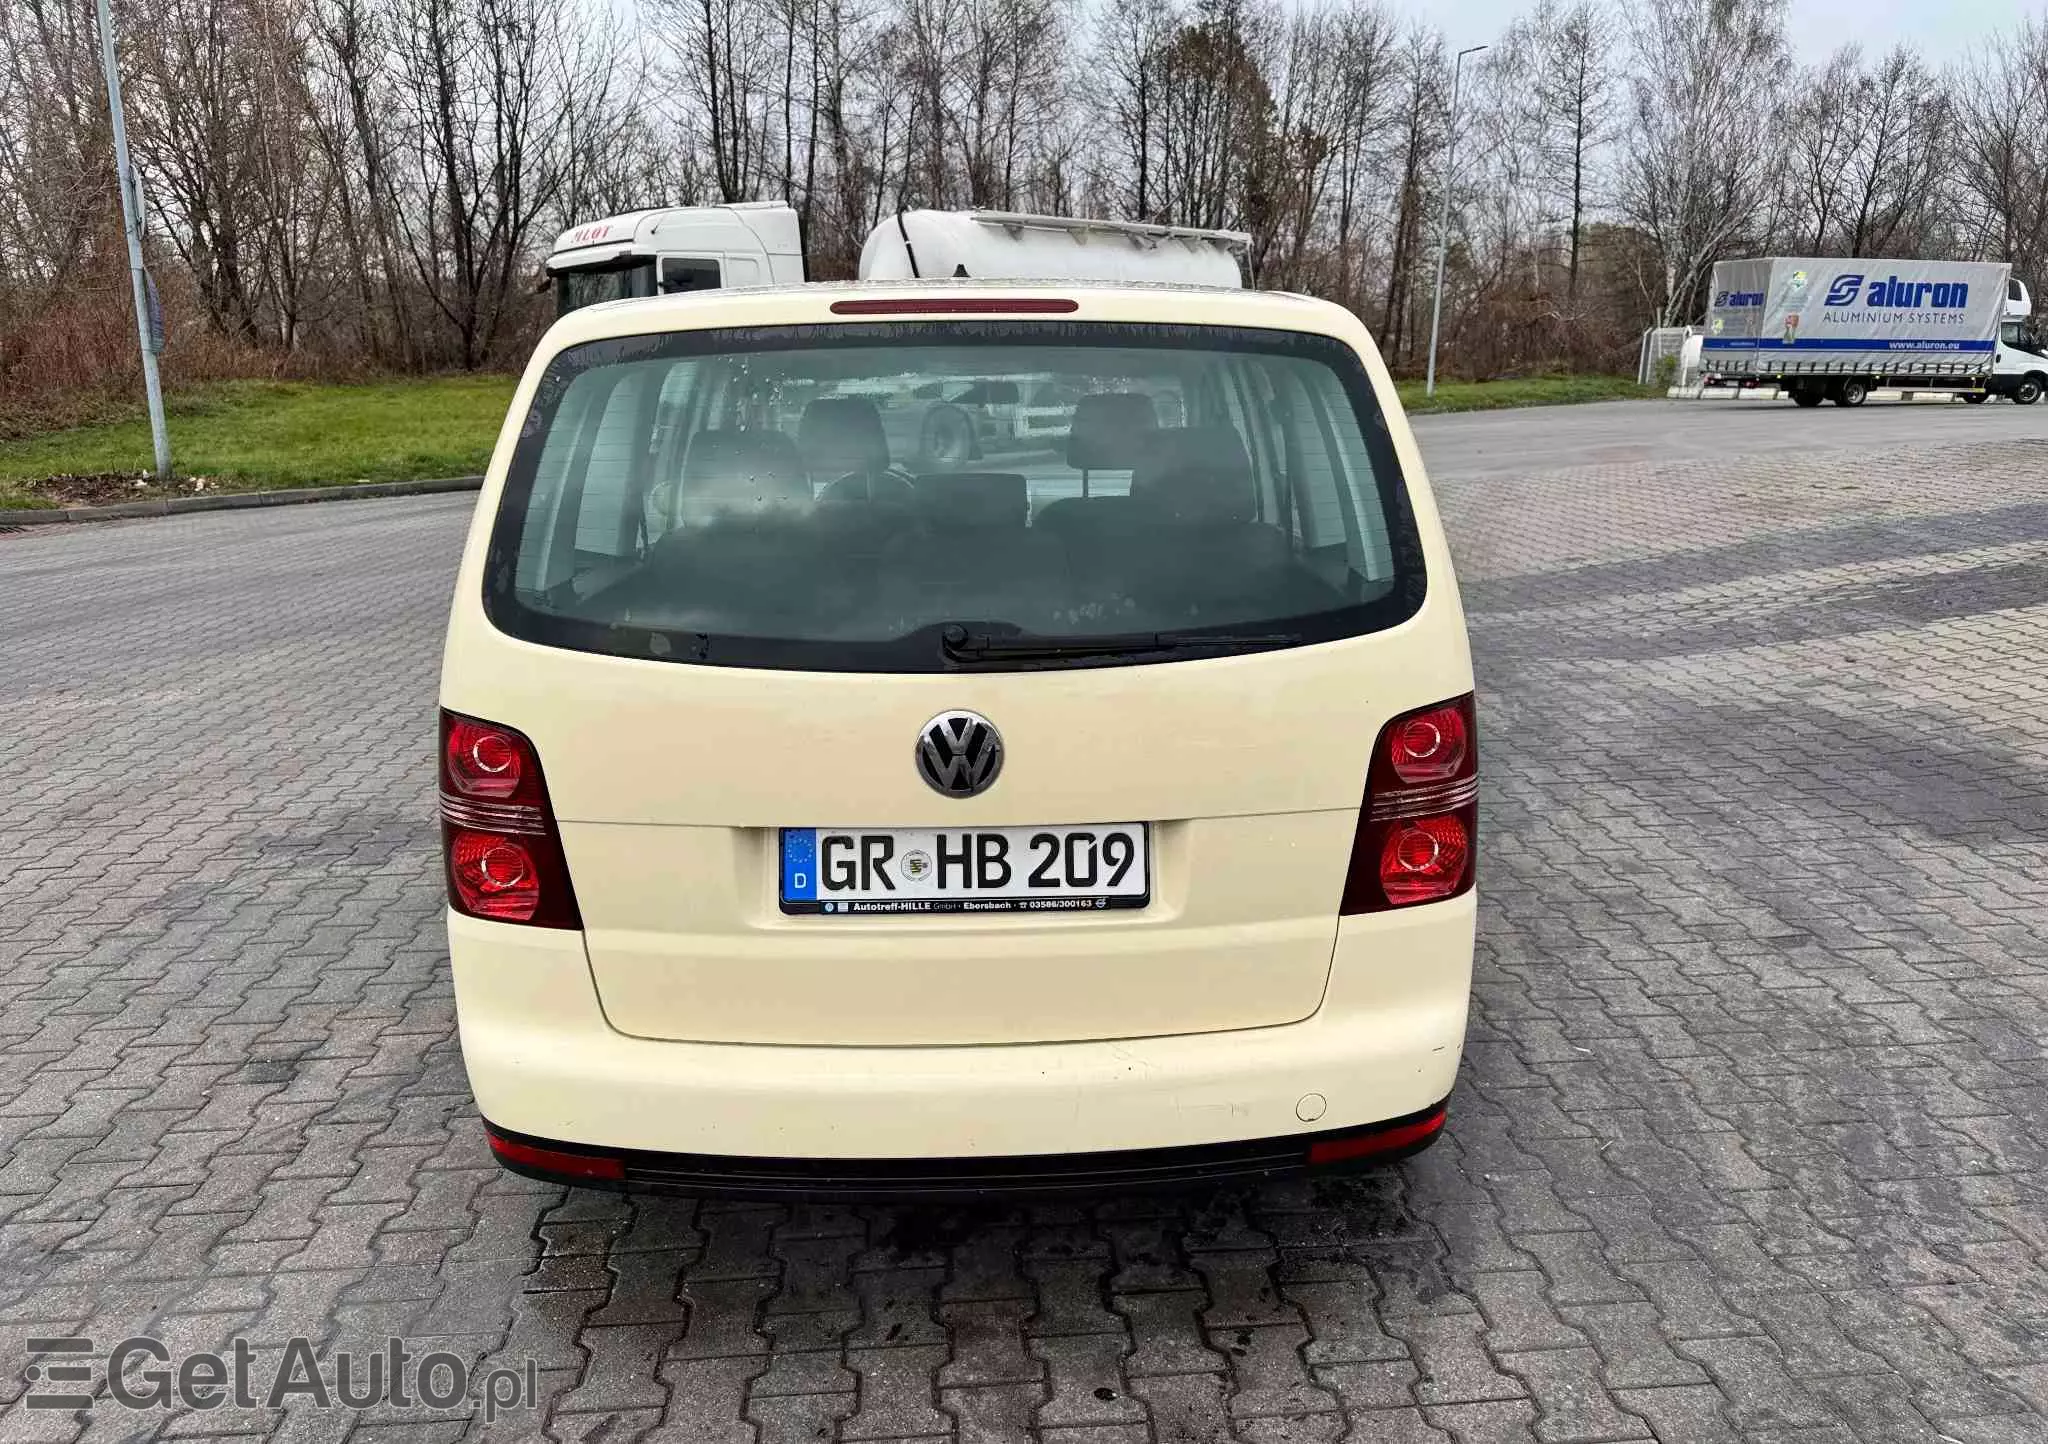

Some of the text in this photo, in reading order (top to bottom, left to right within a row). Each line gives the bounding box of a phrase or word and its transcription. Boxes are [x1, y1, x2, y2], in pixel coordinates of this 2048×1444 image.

[1866, 275, 1969, 308] aluron
[1823, 311, 1965, 325] ALUMINIUM SYSTEMS
[1888, 340, 1960, 350] www.aluron.eu
[821, 832, 1135, 891] GR HB 209
[794, 872, 807, 889] D
[853, 902, 931, 911] Autotreff-HILLE
